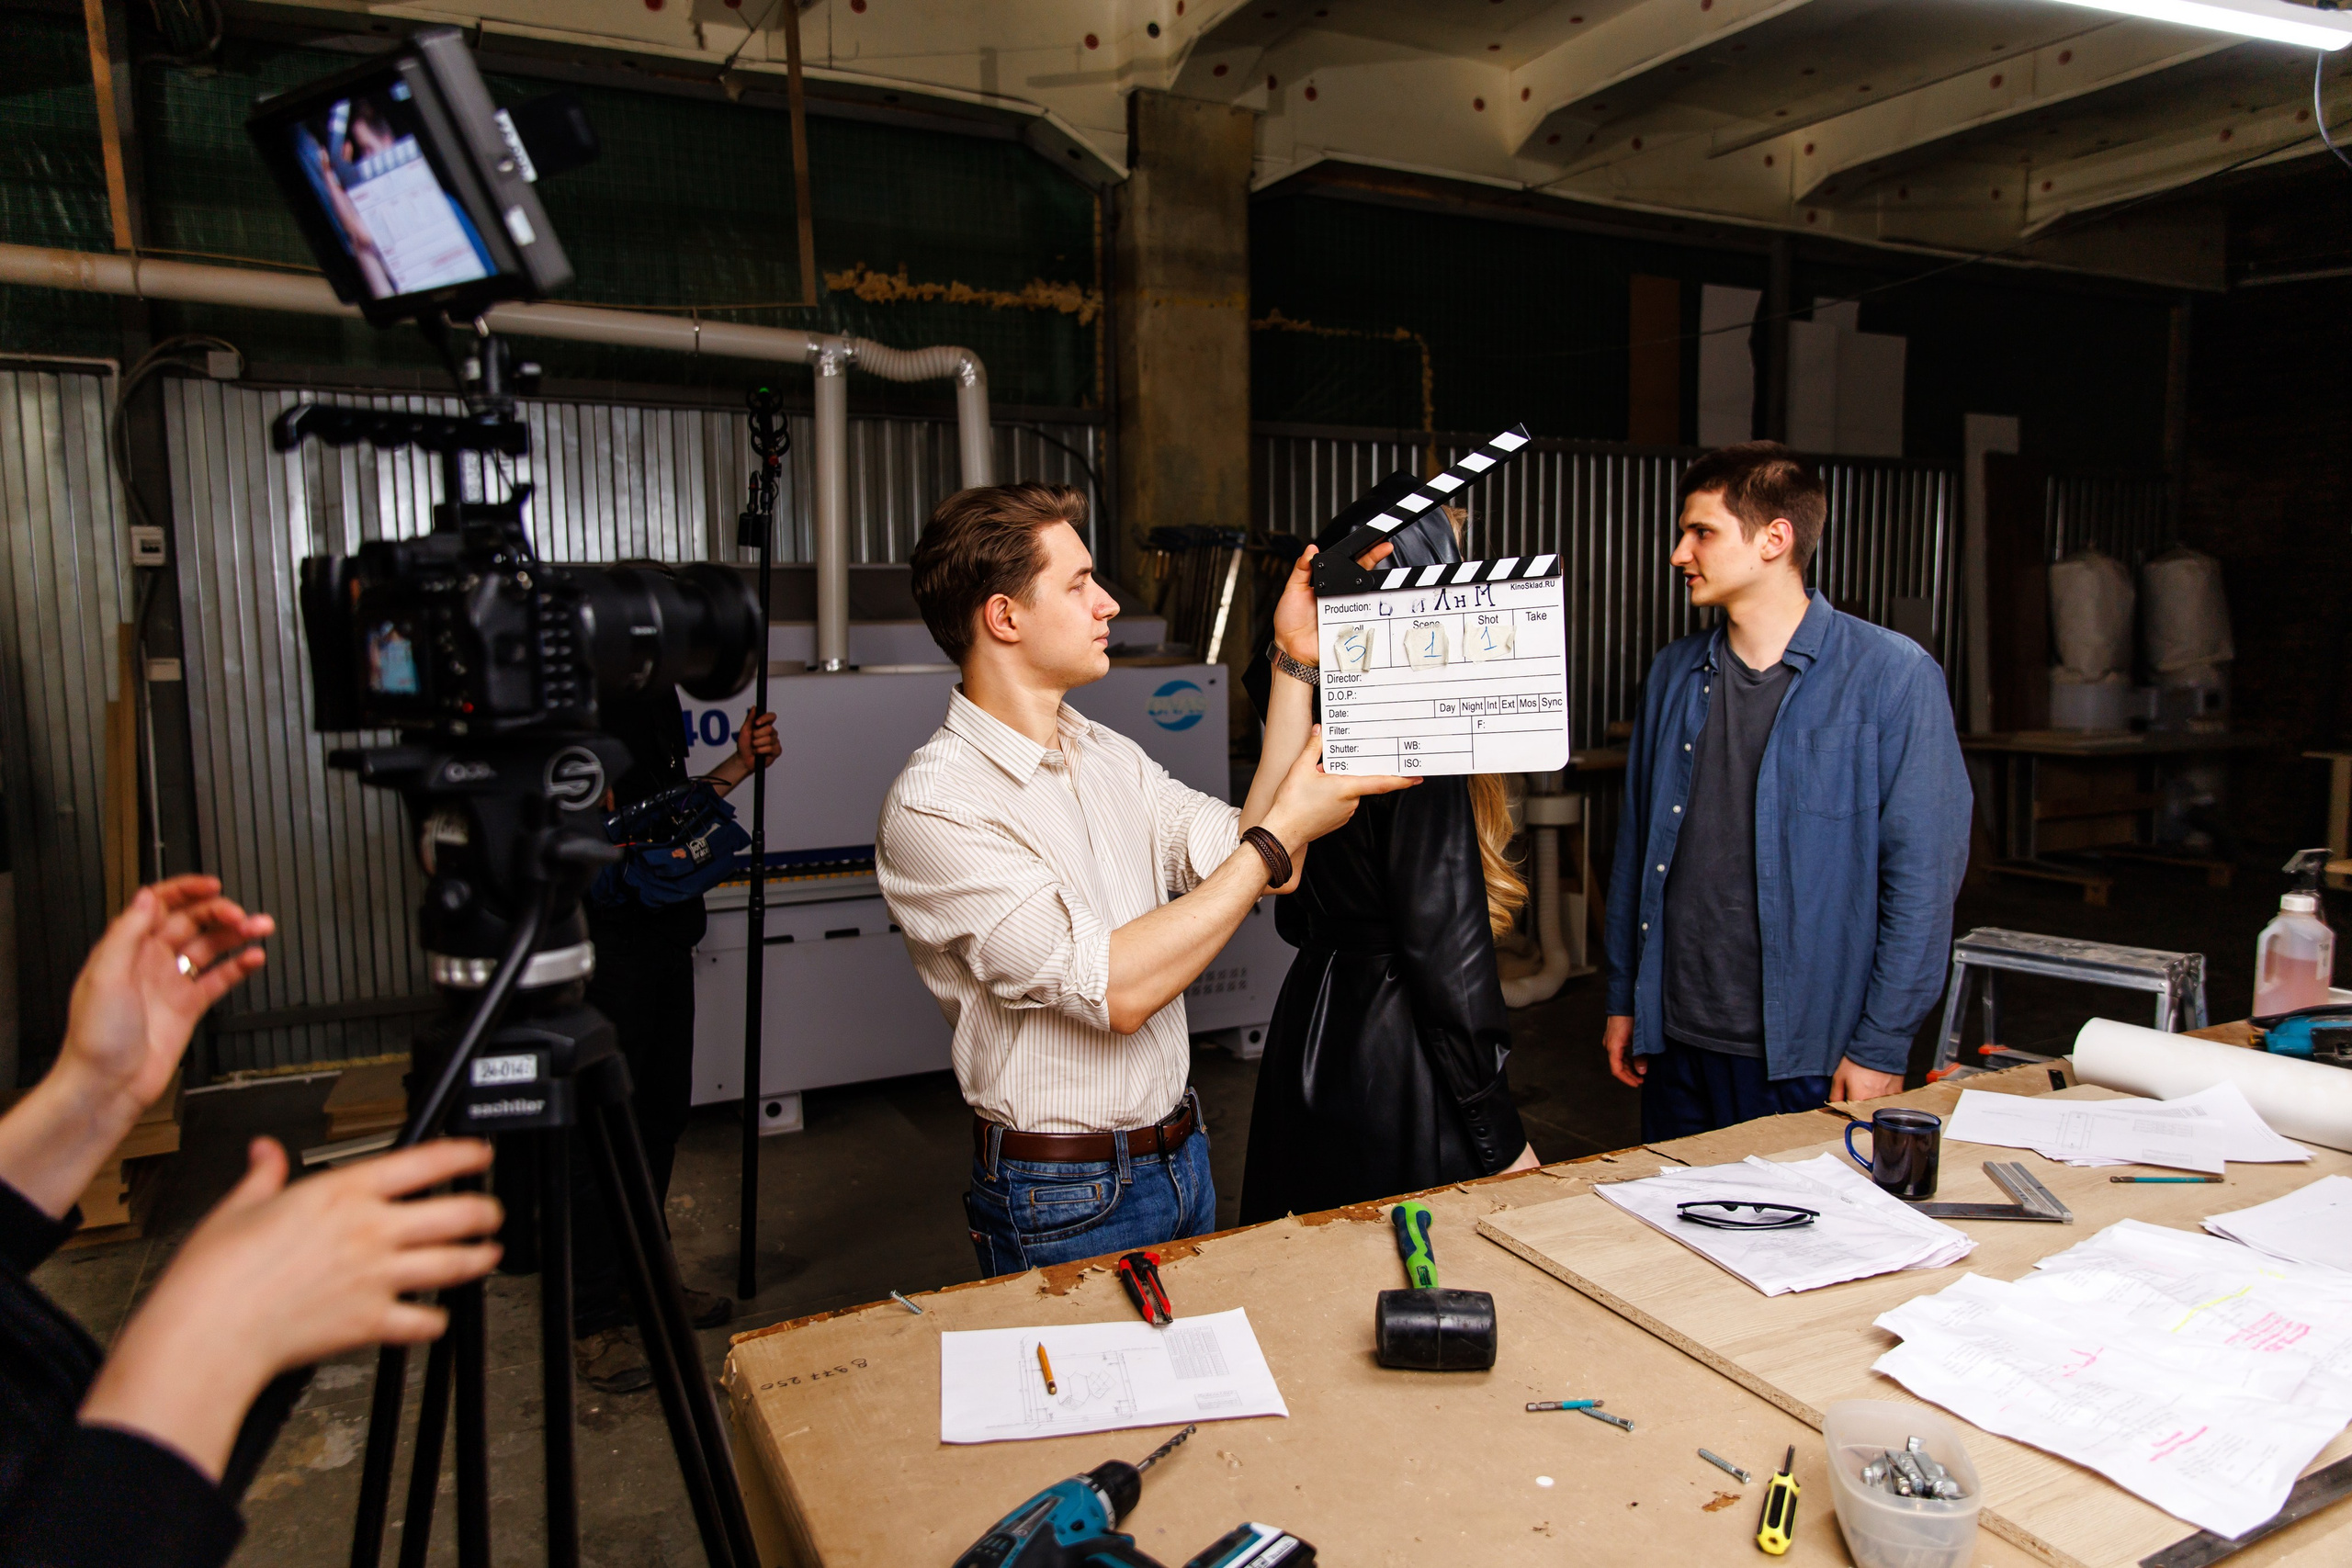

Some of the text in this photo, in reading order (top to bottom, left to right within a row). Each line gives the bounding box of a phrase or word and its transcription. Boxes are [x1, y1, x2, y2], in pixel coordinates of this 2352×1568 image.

[1510, 581, 1555, 591] KinoSklad.RU
[1324, 603, 1372, 615] Production:
[1477, 615, 1498, 625] Shot
[1525, 611, 1547, 622] Take
[1480, 626, 1498, 651] 1
[1344, 635, 1366, 663] 5
[1424, 631, 1442, 658] 1
[1327, 673, 1363, 683] Director:
[1328, 691, 1357, 701] D.O.P.:
[1462, 701, 1484, 713] Night
[1487, 700, 1498, 710] Int
[1501, 699, 1516, 709] Ext
[1519, 698, 1537, 708] Mos
[1542, 697, 1563, 708] Sync
[1329, 709, 1350, 718] Date:
[1440, 703, 1456, 714] Day
[1477, 720, 1486, 728] F:
[1329, 727, 1351, 735] Filter:
[1329, 745, 1360, 754] Shutter:
[1404, 741, 1421, 750] WB:
[1329, 761, 1349, 771] FPS:
[1404, 759, 1422, 768] ISO:
